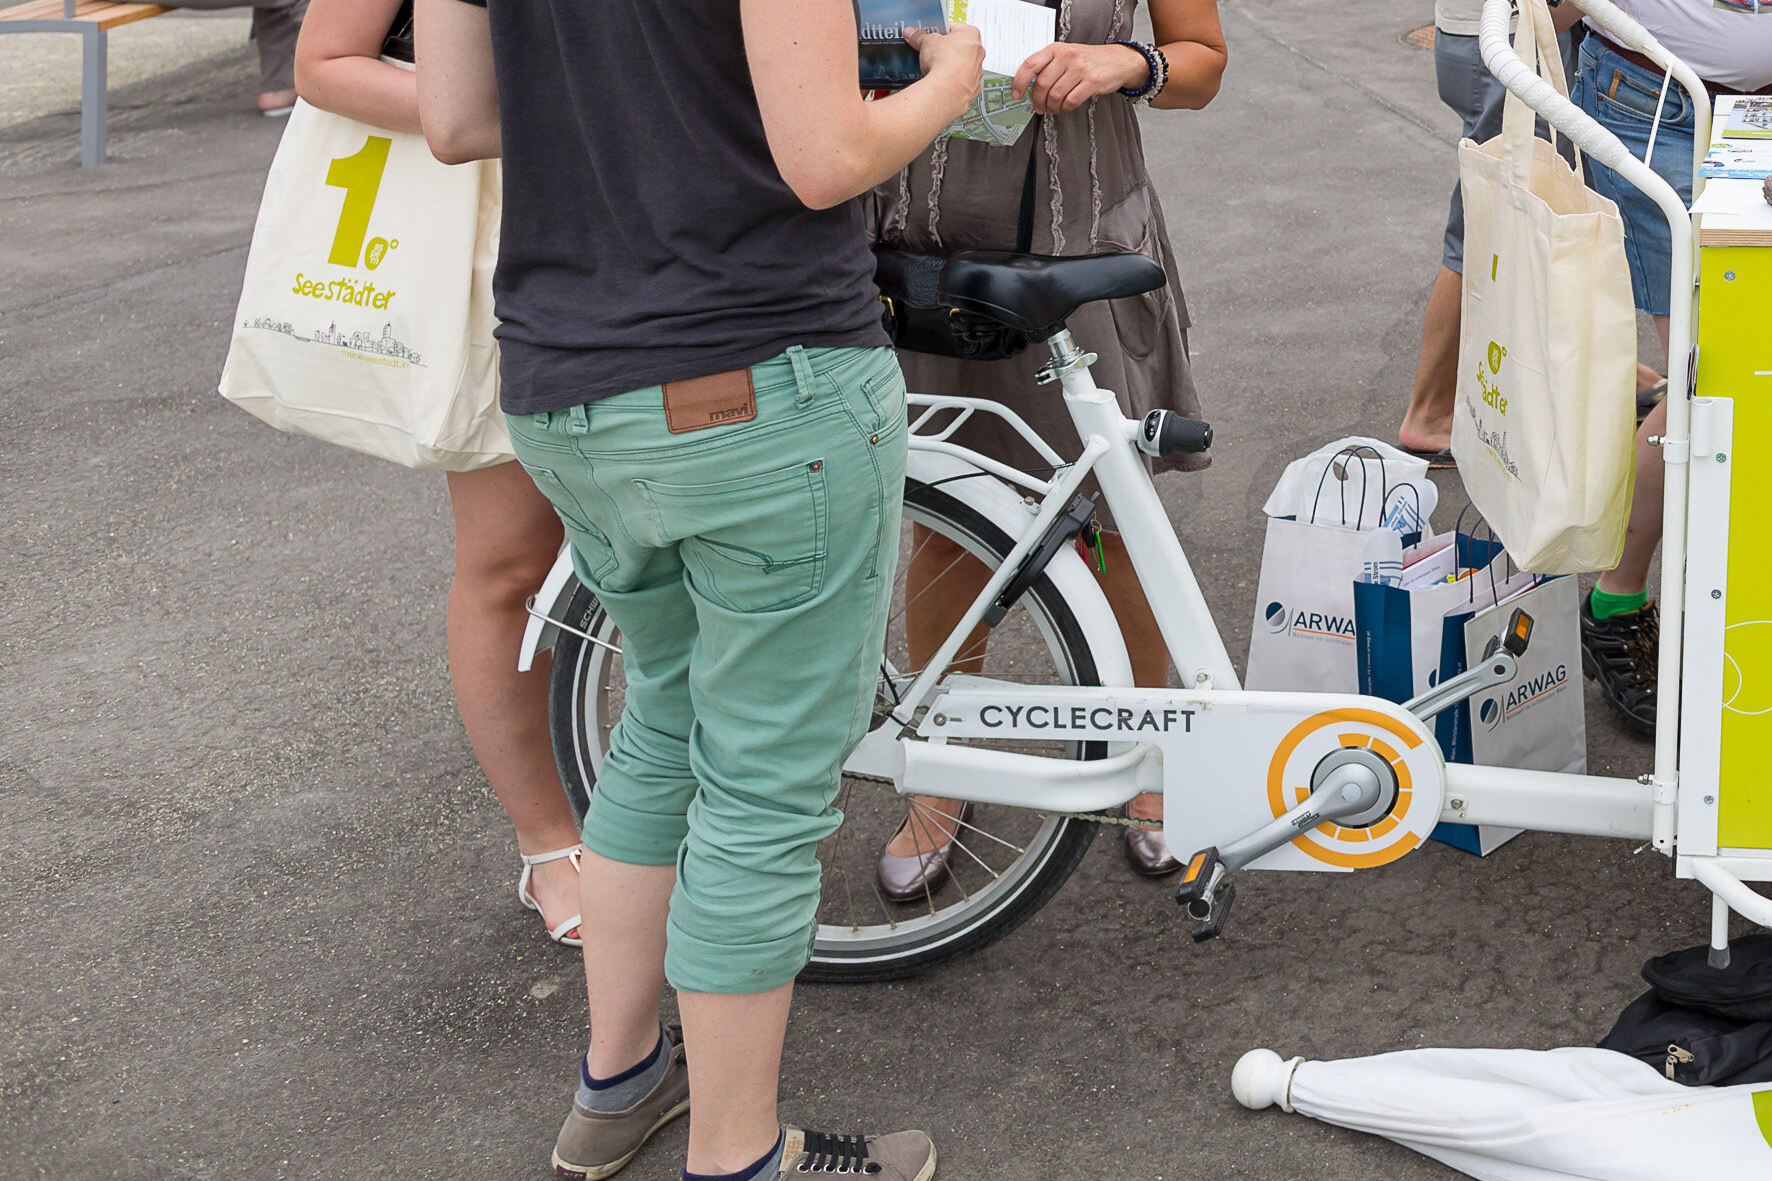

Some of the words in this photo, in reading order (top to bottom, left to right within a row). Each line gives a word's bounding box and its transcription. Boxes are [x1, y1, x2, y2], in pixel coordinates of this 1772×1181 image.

[709, 402, 749, 422] mavi
[1293, 611, 1356, 637] ARWA
[1506, 664, 1567, 711] ARWAG
[978, 702, 1197, 735] CYCLECRAFT
